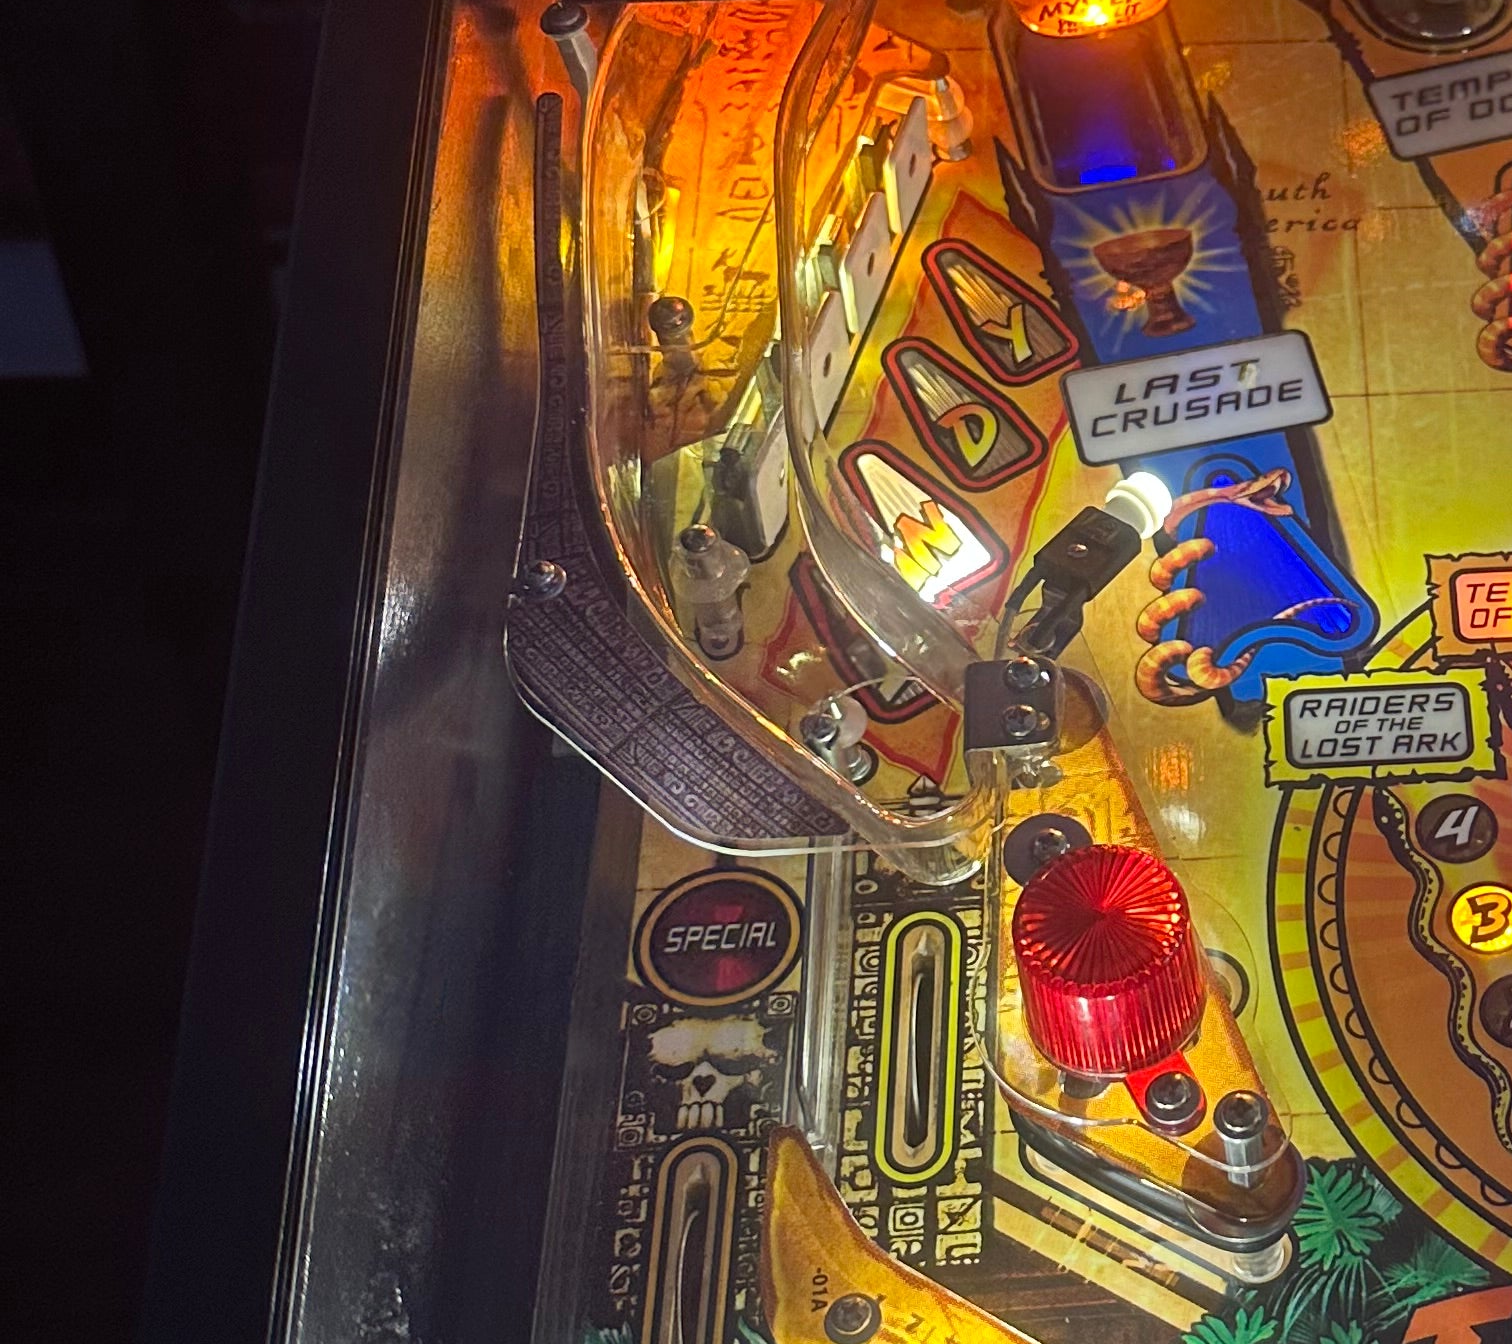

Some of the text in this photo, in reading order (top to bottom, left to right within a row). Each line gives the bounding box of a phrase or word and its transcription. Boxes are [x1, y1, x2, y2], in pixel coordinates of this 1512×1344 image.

[1395, 108, 1450, 137] OF
[1114, 357, 1261, 406] LAST
[1091, 378, 1304, 438] CRUSADE
[1299, 691, 1456, 719] RAIDERS
[1335, 716, 1424, 735] OF THE
[1302, 731, 1463, 759] LOST ARK
[1434, 804, 1480, 847] 4
[1468, 895, 1511, 941] 3
[663, 921, 778, 954] SPECIAL
